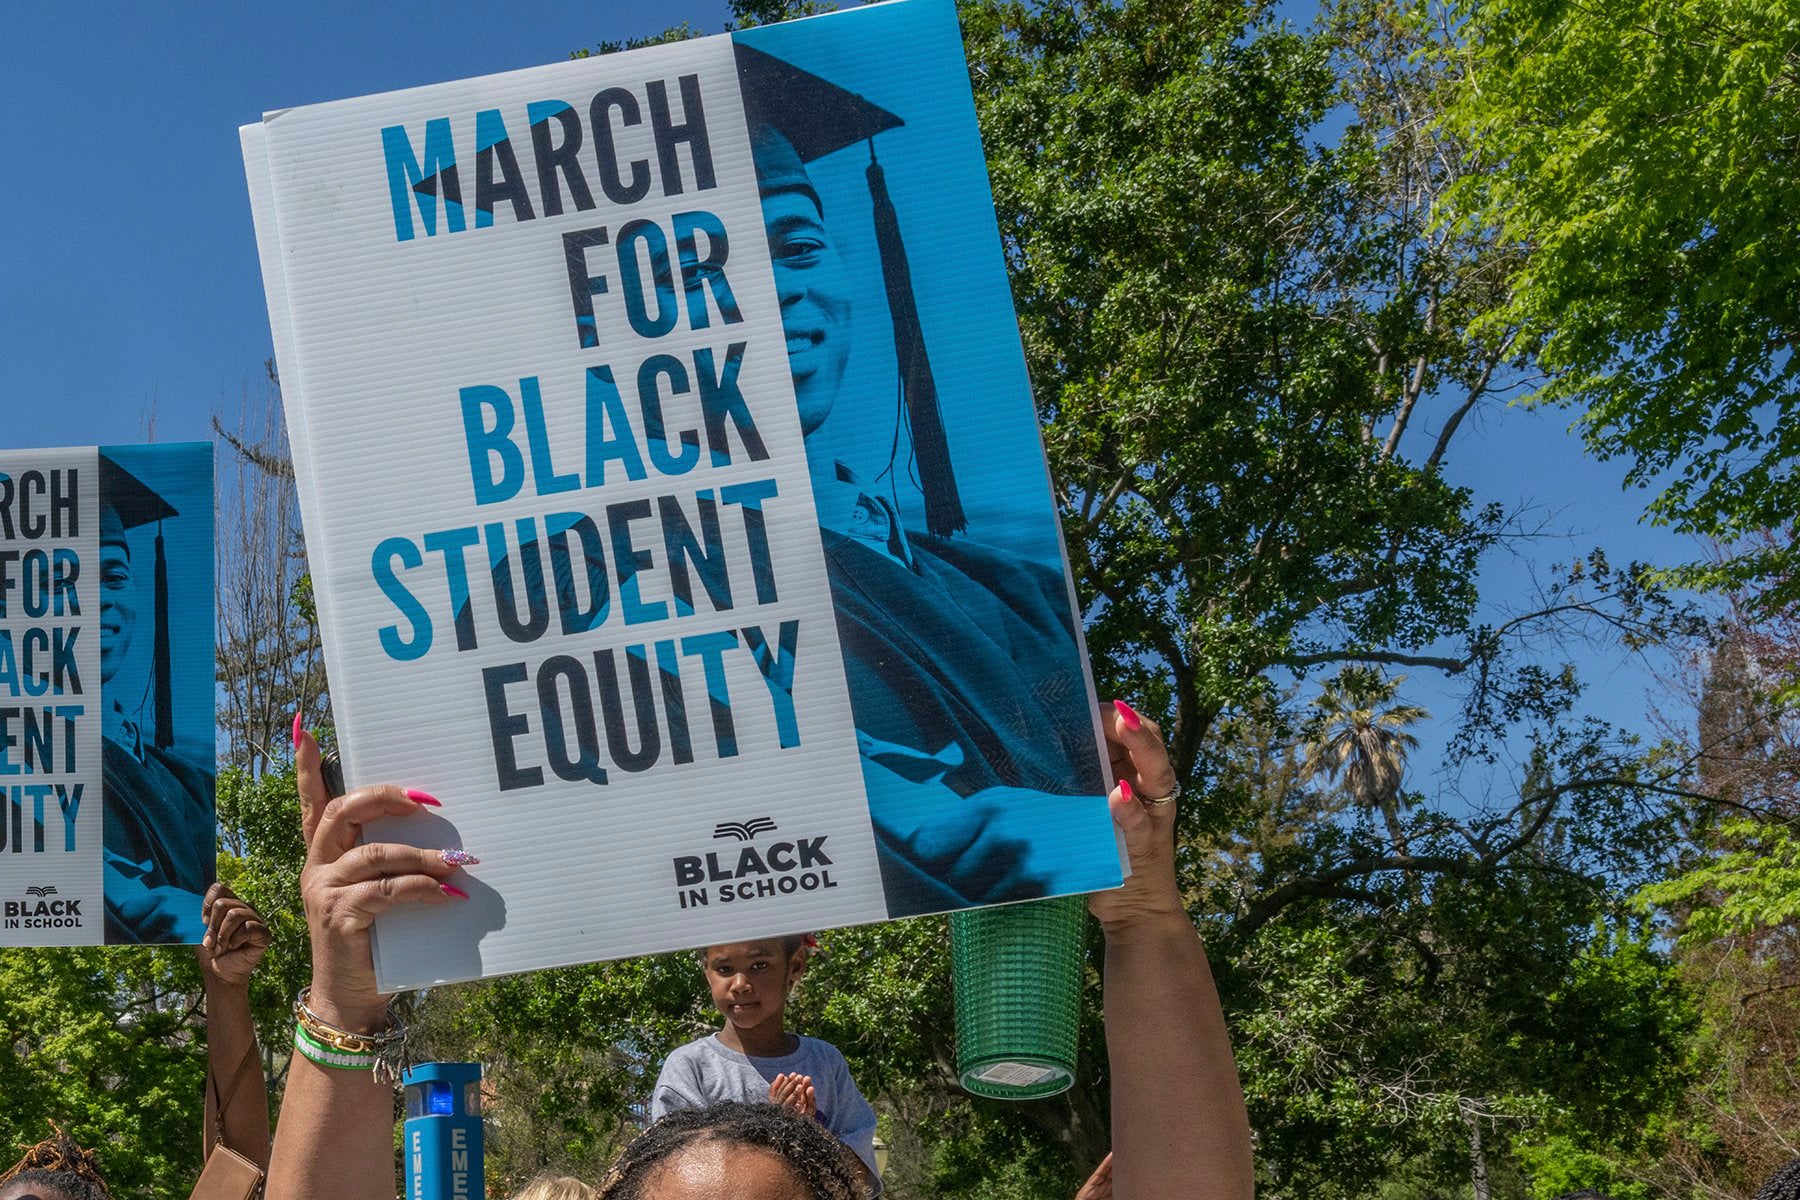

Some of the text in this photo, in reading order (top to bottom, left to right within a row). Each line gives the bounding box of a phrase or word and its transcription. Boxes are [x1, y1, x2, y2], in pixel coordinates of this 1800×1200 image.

[381, 74, 717, 241] MARCH
[561, 210, 743, 348] FOR
[459, 342, 770, 506] BLACK
[370, 478, 780, 661] STUDENT
[482, 619, 800, 791] EQUITY
[4, 899, 82, 917] BLACK
[4, 917, 82, 929] IN SCHOOL
[673, 836, 834, 887] BLACK
[679, 870, 838, 909] IN SCHOOL
